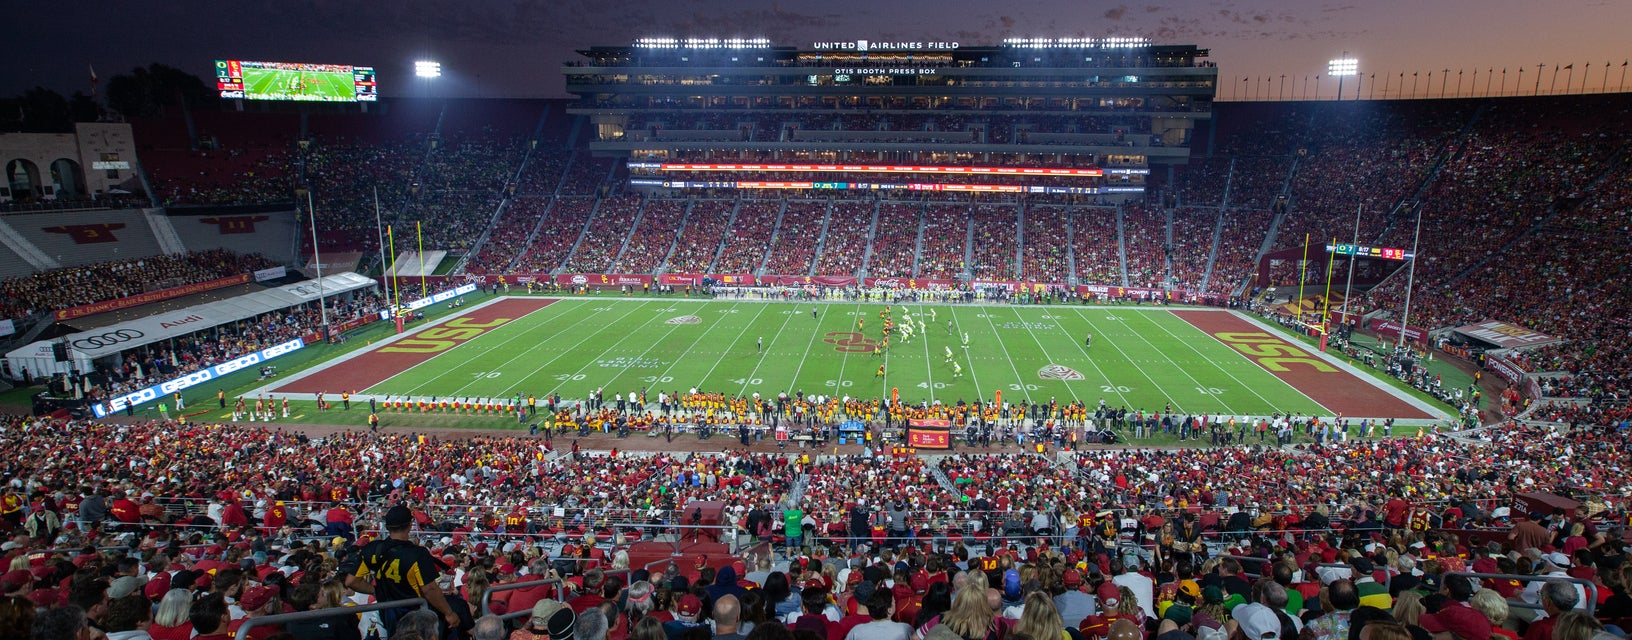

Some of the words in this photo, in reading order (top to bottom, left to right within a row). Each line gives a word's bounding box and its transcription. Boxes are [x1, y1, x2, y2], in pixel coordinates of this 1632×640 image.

[88, 228, 98, 238] 3
[875, 279, 899, 288] Coca-Cola
[87, 304, 109, 313] FRANK
[160, 314, 204, 328] Audi
[377, 317, 512, 352] USC
[1214, 332, 1340, 372] USC
[1083, 518, 1091, 526] 15
[984, 560, 997, 570] 14
